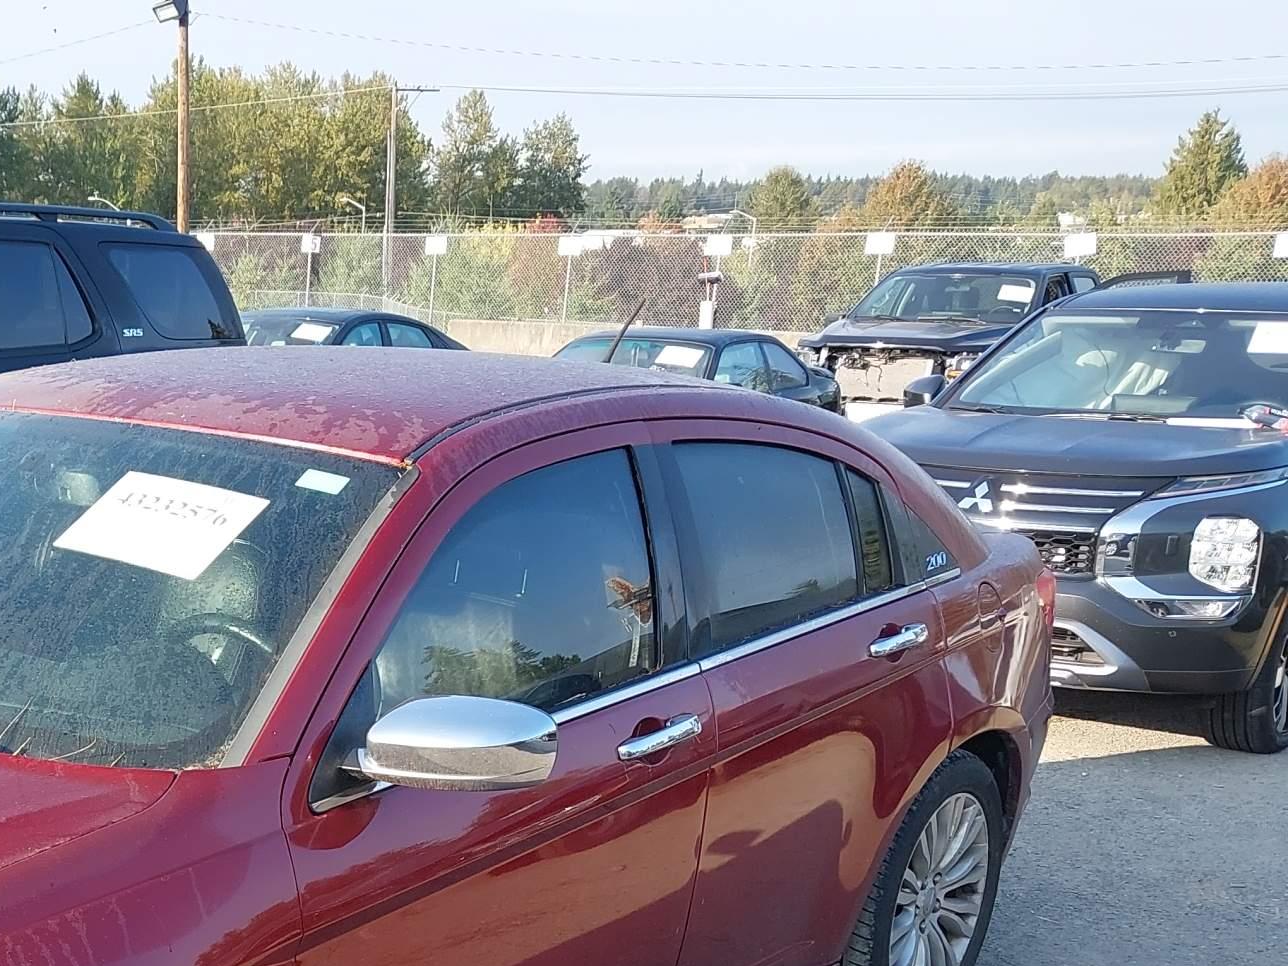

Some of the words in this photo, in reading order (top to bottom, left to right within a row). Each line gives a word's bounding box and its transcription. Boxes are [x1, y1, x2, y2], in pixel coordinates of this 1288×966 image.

[122, 328, 143, 337] SR5
[117, 491, 228, 526] 43232576
[925, 551, 947, 571] 200
